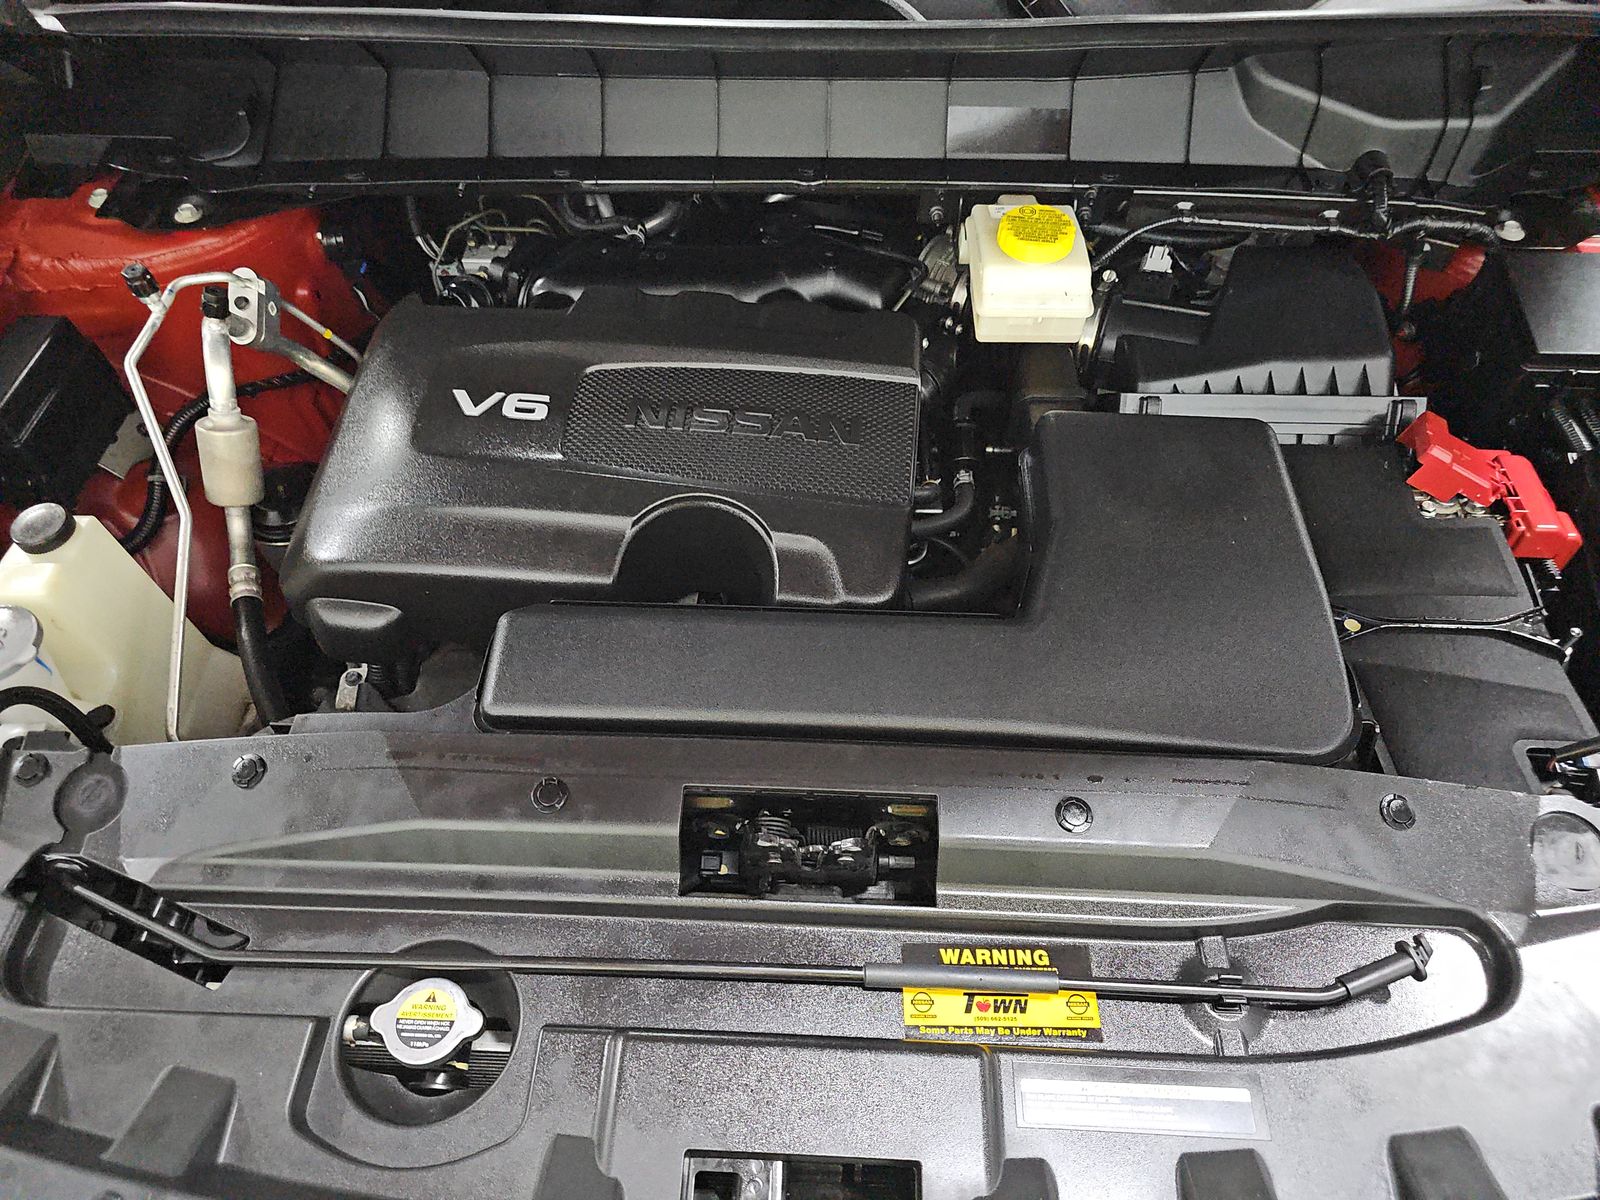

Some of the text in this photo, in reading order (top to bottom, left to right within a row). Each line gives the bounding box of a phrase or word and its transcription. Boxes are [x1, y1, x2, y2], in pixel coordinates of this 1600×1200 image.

[452, 389, 551, 421] V6
[628, 404, 861, 446] NISSAN
[939, 948, 1050, 966] WARNING
[411, 1003, 447, 1011] WARNING
[919, 1026, 1087, 1038] Some Parts May Be Under Warranty
